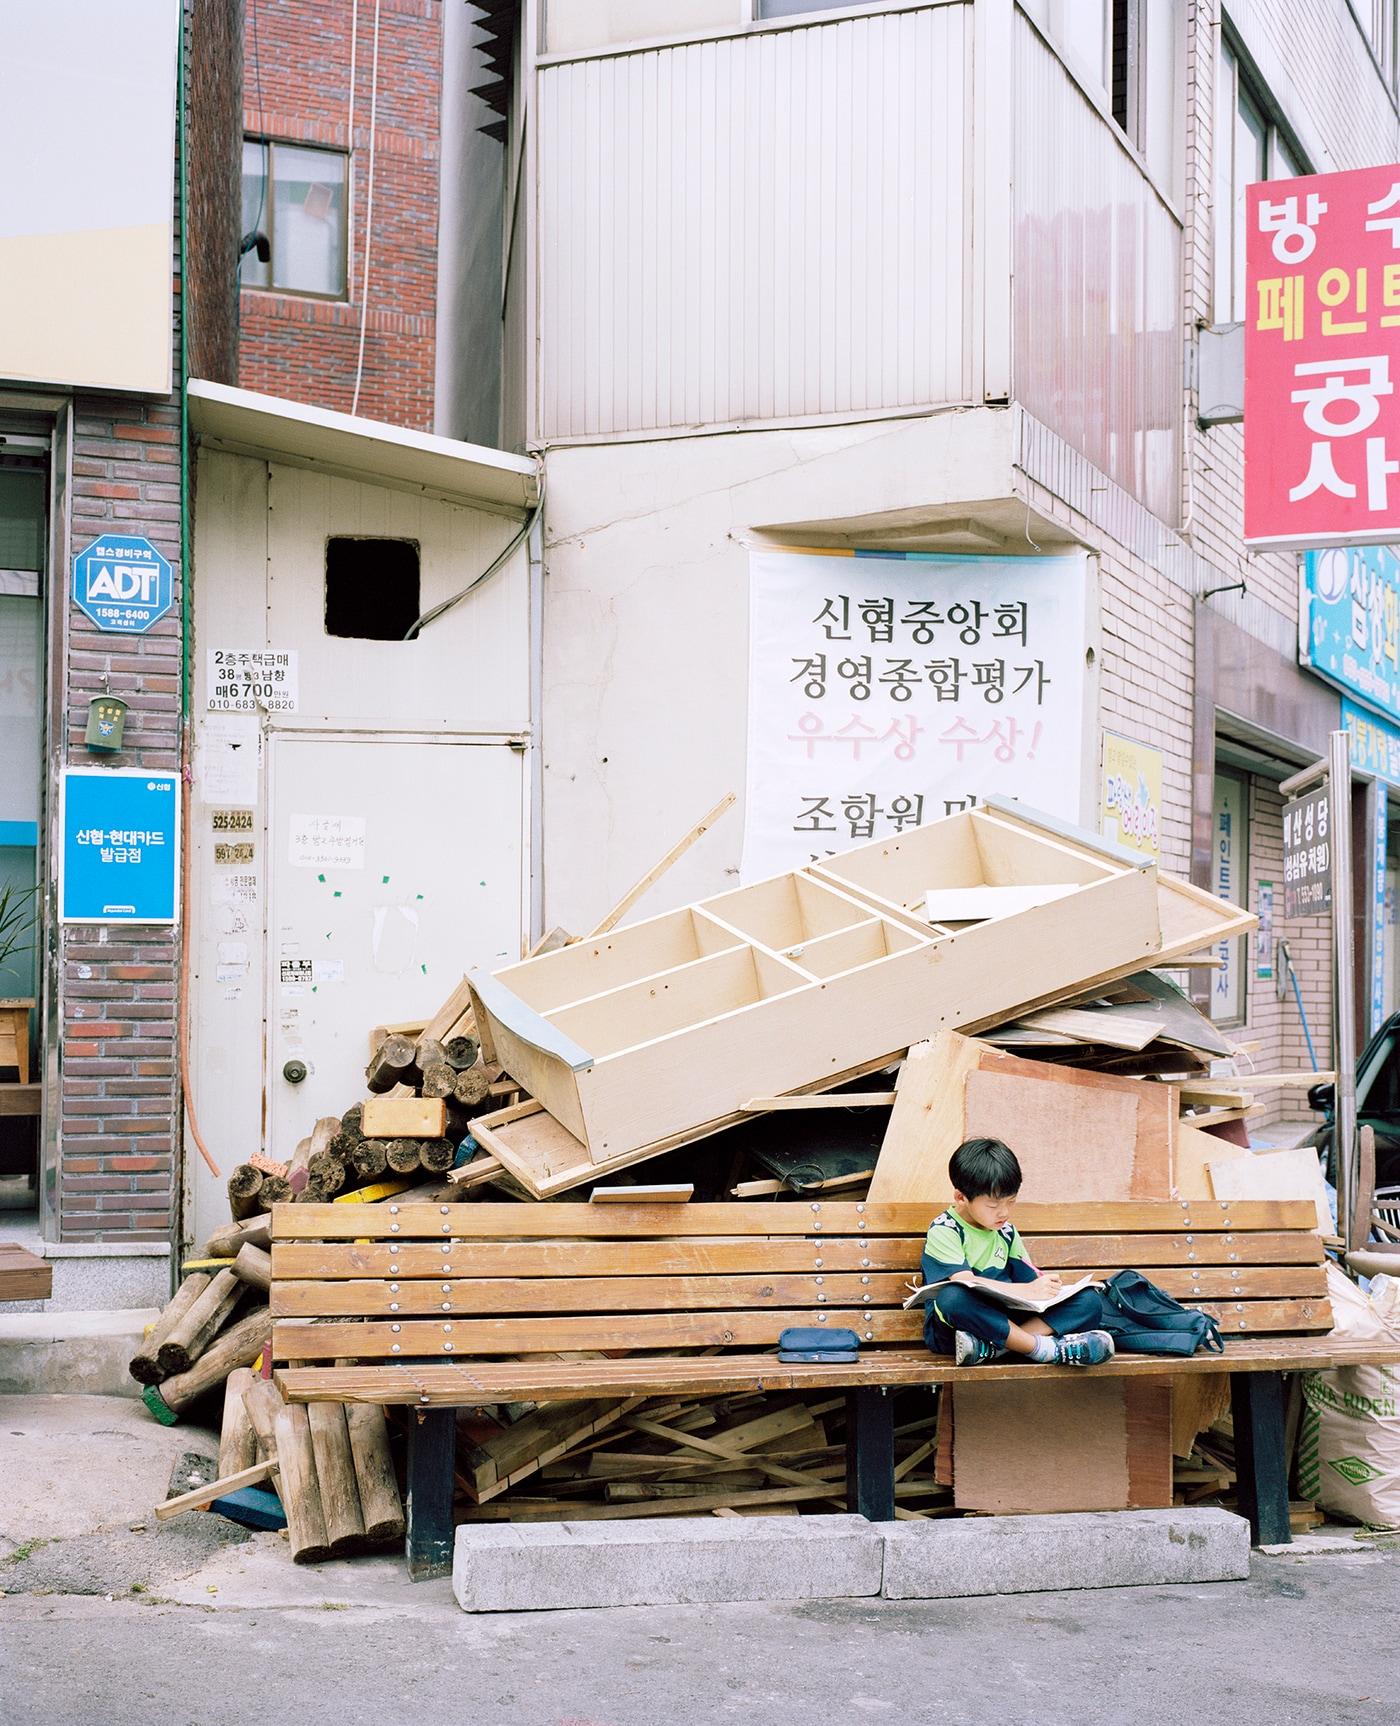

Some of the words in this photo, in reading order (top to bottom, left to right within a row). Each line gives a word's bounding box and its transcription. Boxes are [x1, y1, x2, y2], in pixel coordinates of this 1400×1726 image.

[89, 565, 159, 601] ADT
[96, 607, 150, 620] 1588-6400
[812, 594, 1028, 647] 신협중앙회
[215, 651, 289, 666] 2층주택급매
[262, 669, 285, 681] 남향
[790, 652, 1051, 704] 경영종합평가
[787, 711, 925, 762] 우수상
[938, 714, 1043, 763] 수상!
[156, 782, 171, 792] 신협
[793, 793, 925, 839] 조합원
[75, 829, 165, 847] 신협-현대카드
[100, 848, 142, 864] 발급점
